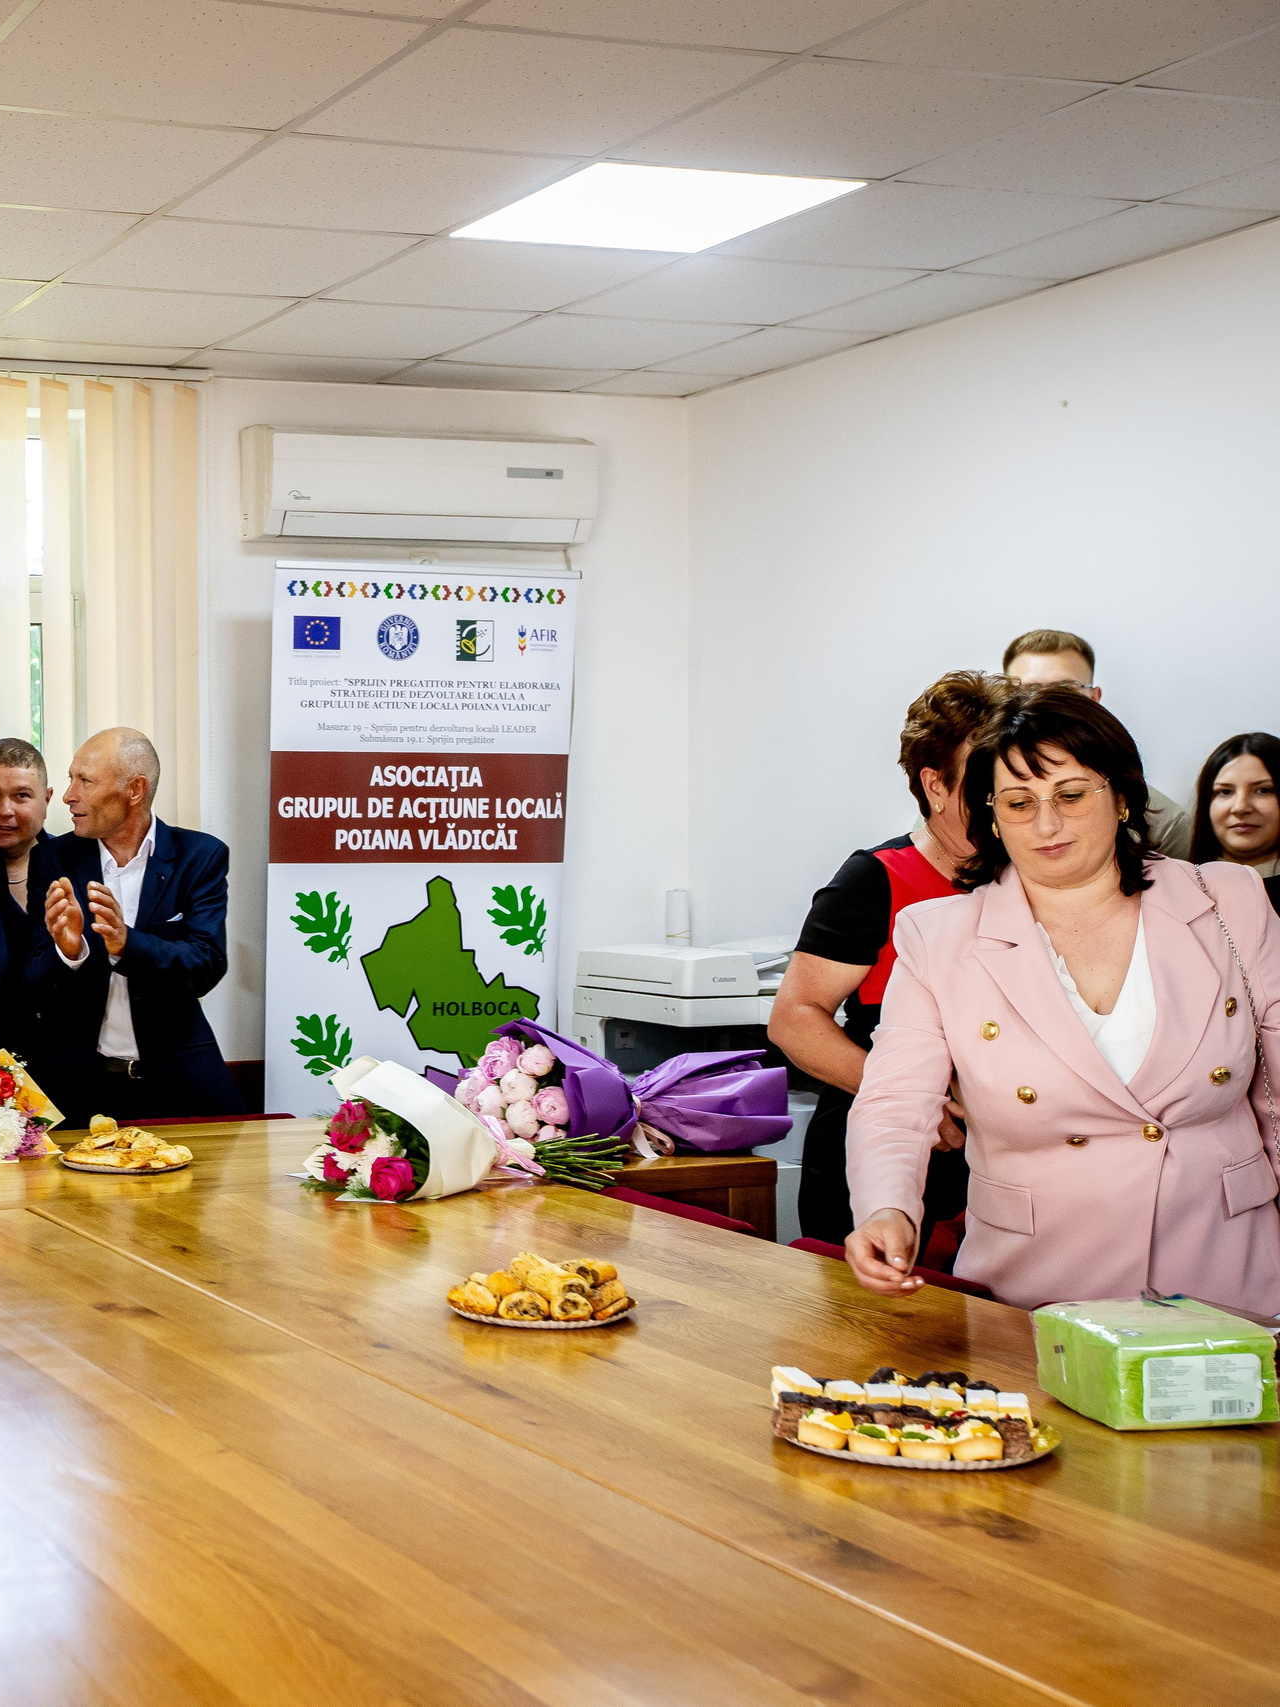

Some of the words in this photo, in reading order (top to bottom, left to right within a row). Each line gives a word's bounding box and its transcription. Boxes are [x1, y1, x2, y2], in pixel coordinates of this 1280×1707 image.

[380, 616, 416, 632] GUVERNUL
[530, 628, 558, 642] AFIR
[288, 677, 308, 686] Titlu
[310, 678, 342, 688] proiect:
[390, 679, 454, 688] PREGATITOR
[456, 680, 496, 689] PENTRU
[500, 682, 560, 690] ELABORAREA
[330, 689, 390, 698] STRATEGIEI
[392, 690, 406, 698] DE
[409, 690, 474, 699] DEZVOLTARE
[477, 692, 516, 700] LOCALA
[518, 692, 525, 700] A
[300, 700, 354, 708] GRUPULUI
[357, 701, 370, 709] DE
[372, 702, 418, 710] ACTIUNE
[420, 702, 459, 710] LOCALA
[462, 702, 499, 711] POIANA
[353, 724, 362, 732] 19
[370, 723, 398, 733] Sprijin
[400, 724, 427, 734] pentru
[430, 724, 474, 732] dezvoltarea
[502, 725, 537, 734] LEADER
[406, 736, 425, 744] 19.1:
[426, 734, 454, 744] Sprijin
[278, 797, 362, 818] GRUPUL
[367, 798, 394, 818] DE
[496, 792, 563, 819] LOCALĂ
[335, 829, 414, 850] POIANA
[418, 823, 518, 850] VLĂDICĂI
[433, 1001, 521, 1016] HOLBOCA
